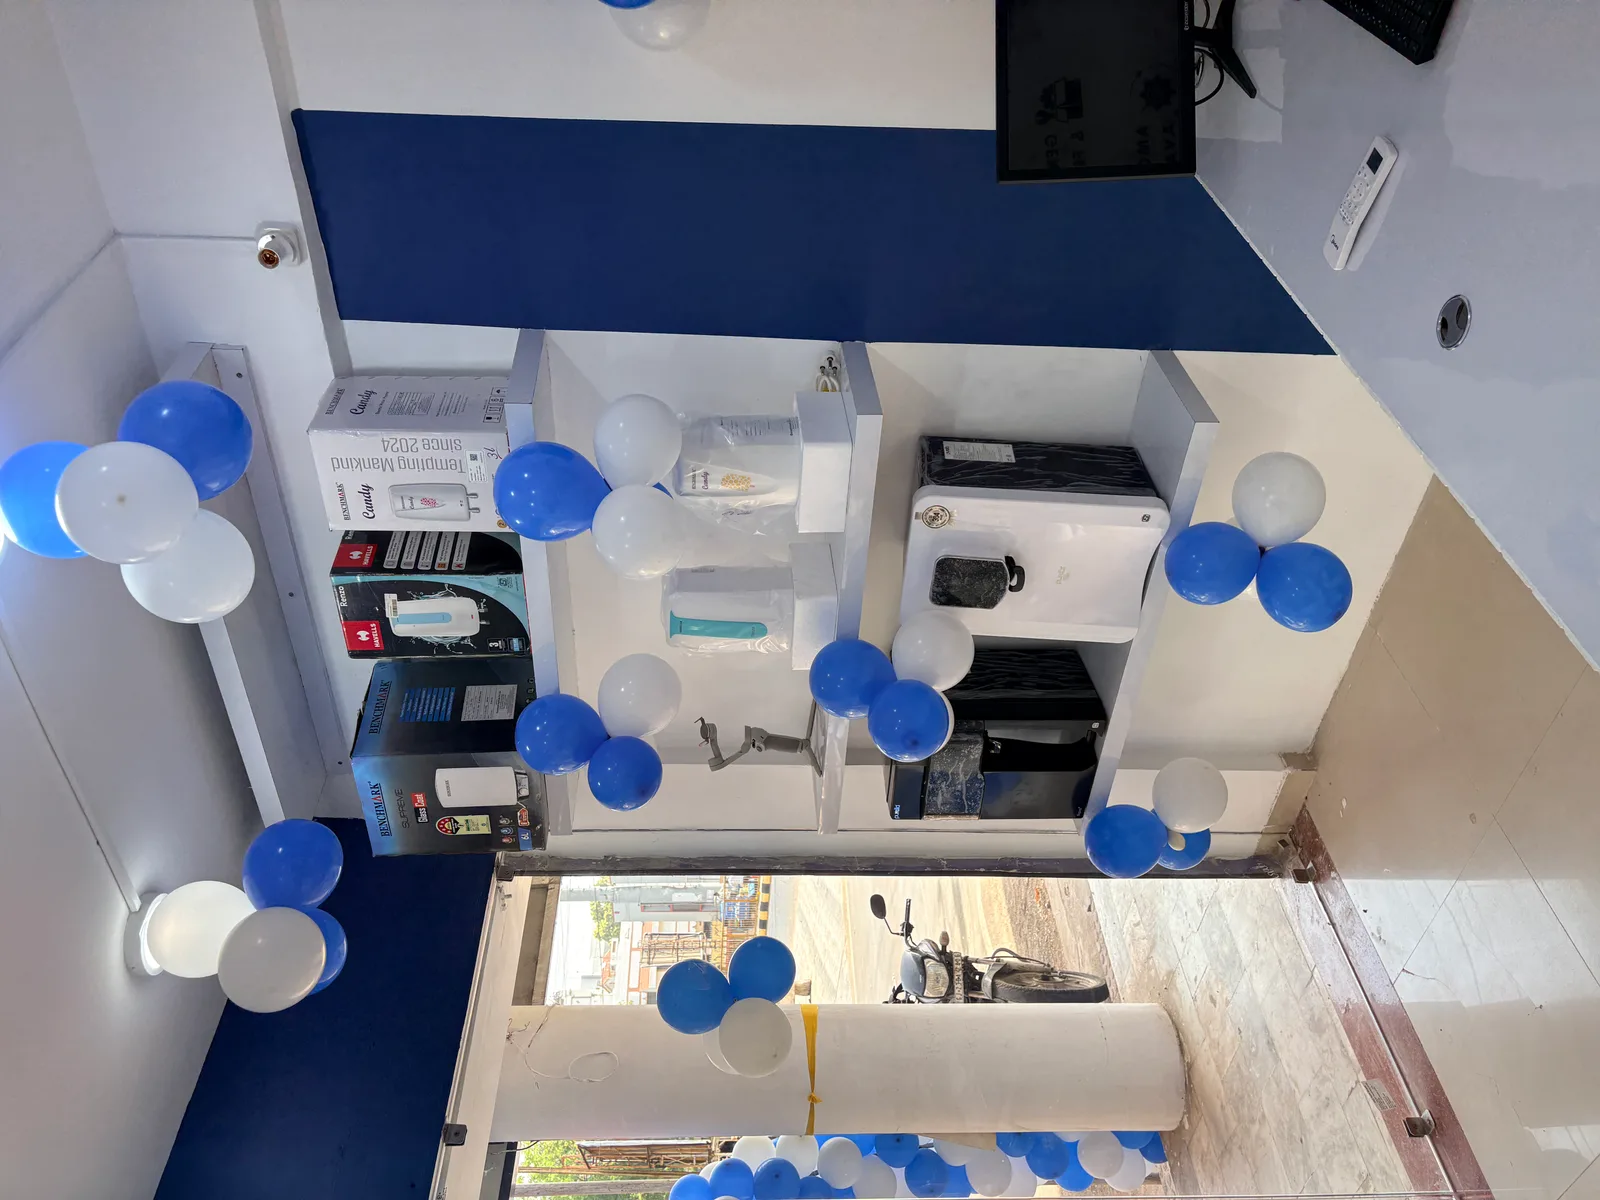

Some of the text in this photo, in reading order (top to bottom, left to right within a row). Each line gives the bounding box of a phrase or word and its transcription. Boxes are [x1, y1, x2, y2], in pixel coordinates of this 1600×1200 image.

[349, 389, 377, 415] Candy
[381, 437, 462, 453] since 2024
[331, 456, 395, 472] Mankind
[397, 456, 466, 474] Tempting
[336, 483, 350, 521] BENCHMARK
[357, 483, 376, 520] Candy
[362, 545, 374, 566] HAVELLS
[338, 585, 348, 607] Renzo
[370, 623, 381, 648] HAVELLS
[369, 680, 391, 735] BENCHMARK
[369, 782, 392, 838] BENCHMARK
[414, 793, 429, 823] Glass Coat
